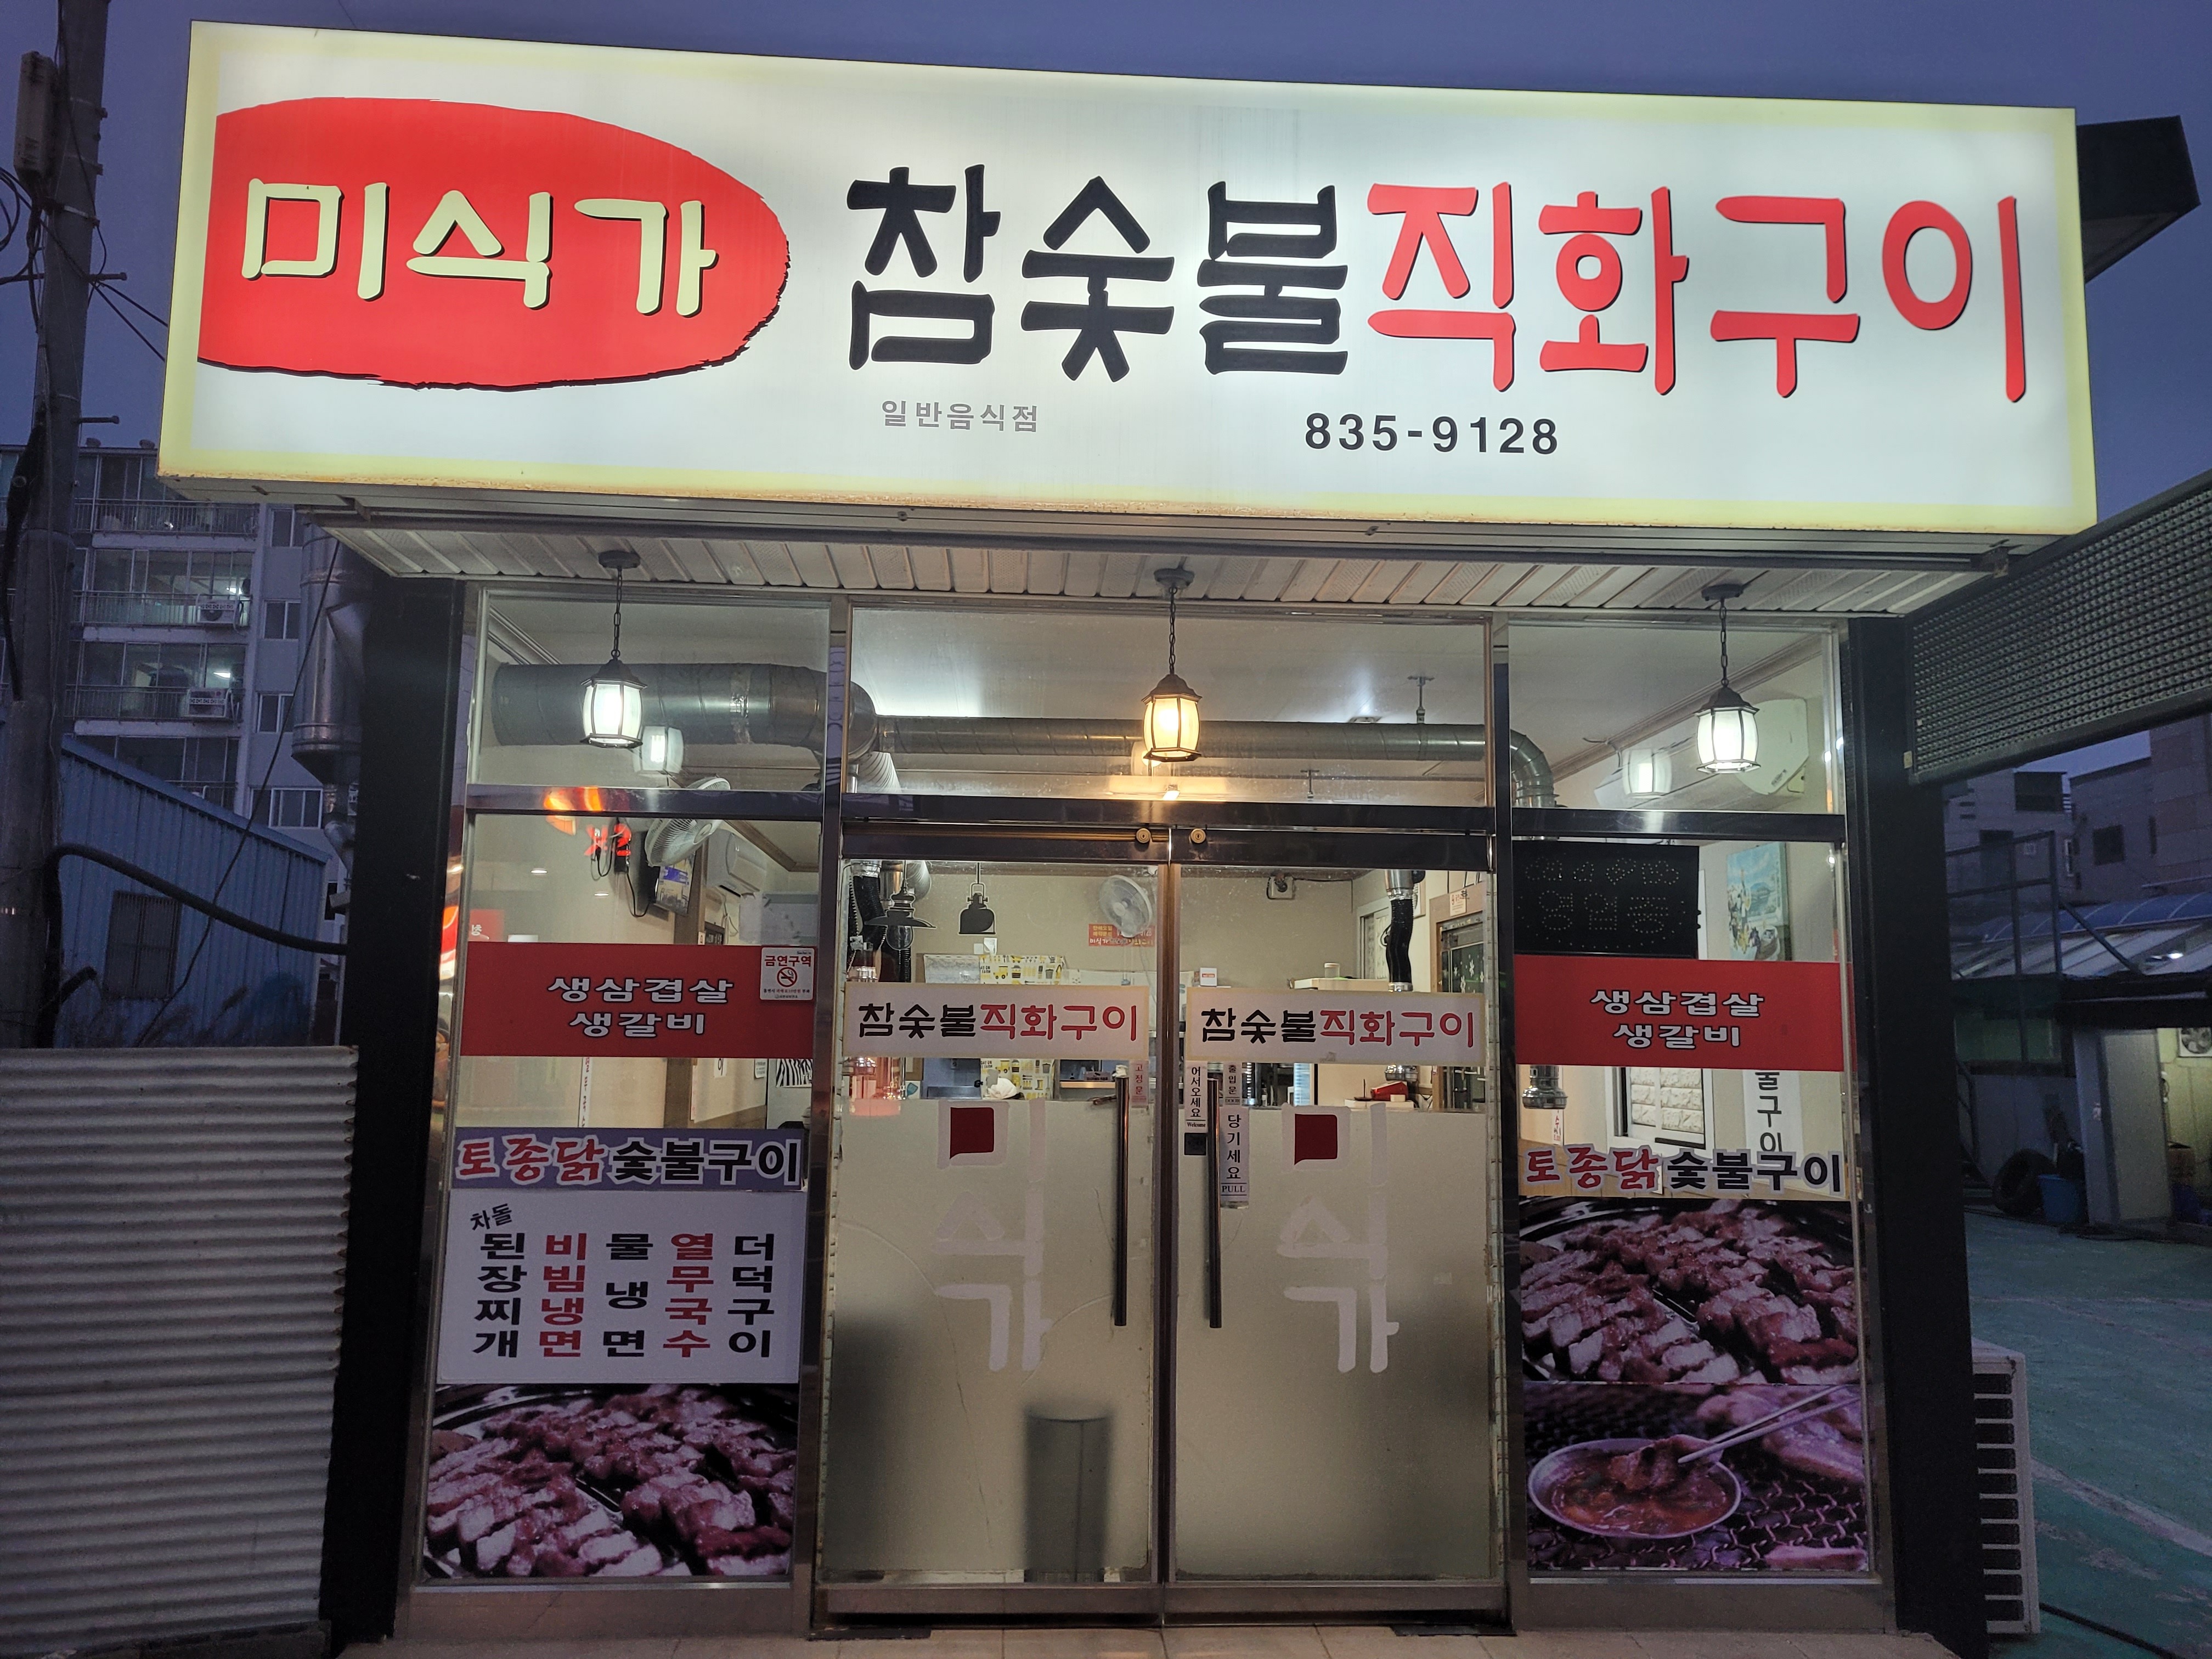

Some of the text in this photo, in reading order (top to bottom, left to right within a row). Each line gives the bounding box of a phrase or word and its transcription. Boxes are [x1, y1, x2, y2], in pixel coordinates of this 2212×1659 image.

[242, 178, 718, 317] 미식가
[882, 399, 1039, 433] 일반음식점
[1305, 413, 1559, 456] 835-9128
[1539, 891, 1668, 933] 영업중
[764, 956, 811, 967] 금연구역
[548, 977, 734, 1004] 생삼겹살
[1590, 989, 1765, 1018] 생삼겹살
[569, 1013, 706, 1037] 생갈비
[1613, 1024, 1740, 1049] 생갈비
[1190, 1066, 1201, 1118] 어서오세요
[1228, 1064, 1237, 1095] 출입문
[1226, 1114, 1242, 1179] 당기세요
[470, 1204, 512, 1232] 차돌
[472, 1233, 527, 1358] 된장찌개
[539, 1233, 587, 1358] 비빔냉면
[603, 1233, 654, 1357] 물냉면
[663, 1233, 714, 1358] 열무국수
[727, 1233, 775, 1358] 더덕구이
